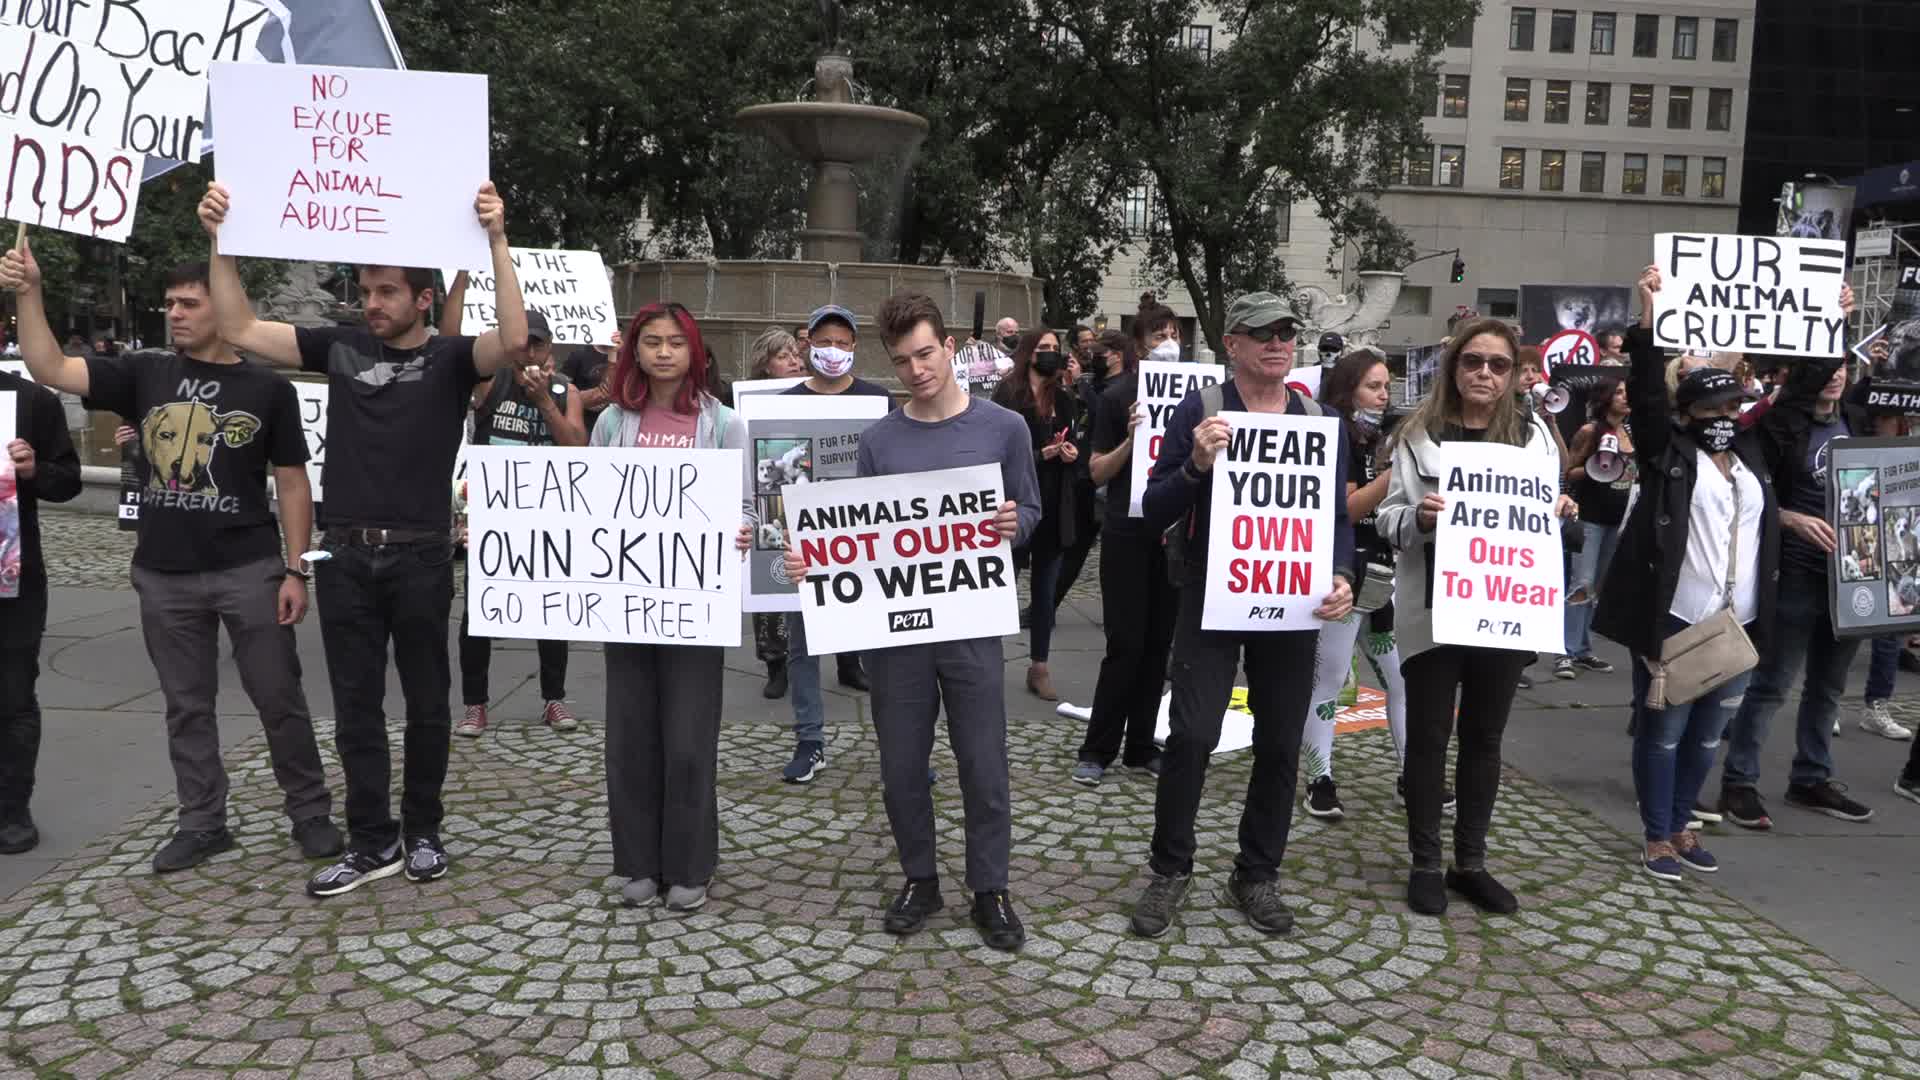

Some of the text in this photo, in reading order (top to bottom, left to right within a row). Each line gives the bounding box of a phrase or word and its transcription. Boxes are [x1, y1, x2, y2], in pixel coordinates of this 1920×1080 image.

[30, 41, 100, 136] On
[120, 63, 202, 160] Your
[312, 74, 348, 101] NO
[293, 106, 392, 136] EXCUSE
[313, 137, 368, 164] FOR
[288, 170, 402, 199] ANIMAL
[280, 202, 389, 233] ABUSE
[528, 253, 573, 273] THE
[1671, 235, 1782, 287] FUR
[1686, 283, 1822, 313] ANIMAL
[1656, 309, 1844, 354] CRUELTY
[177, 378, 220, 399] NO
[1868, 392, 1920, 408] DEATH
[492, 414, 530, 433] THEIRS
[820, 433, 860, 448] FUR FAR
[820, 450, 860, 465] SURVIV
[1226, 428, 1326, 467] WEAR
[481, 460, 711, 522] WEAR YOUR
[1229, 471, 1321, 510] YOUR
[1447, 467, 1552, 503] Animals
[797, 489, 998, 531] ANIMALS ARE
[1450, 501, 1552, 536] Are Not
[800, 519, 1001, 567] NOT OURS
[1232, 514, 1313, 552] OWN
[479, 529, 571, 580] OWN
[591, 527, 723, 590] SKIN!
[1469, 537, 1535, 568] Ours
[805, 555, 1007, 606] TO WEAR
[1227, 558, 1312, 595] SKIN
[1442, 571, 1558, 607] To Wear
[481, 587, 522, 624] GO
[542, 591, 611, 632] FUR
